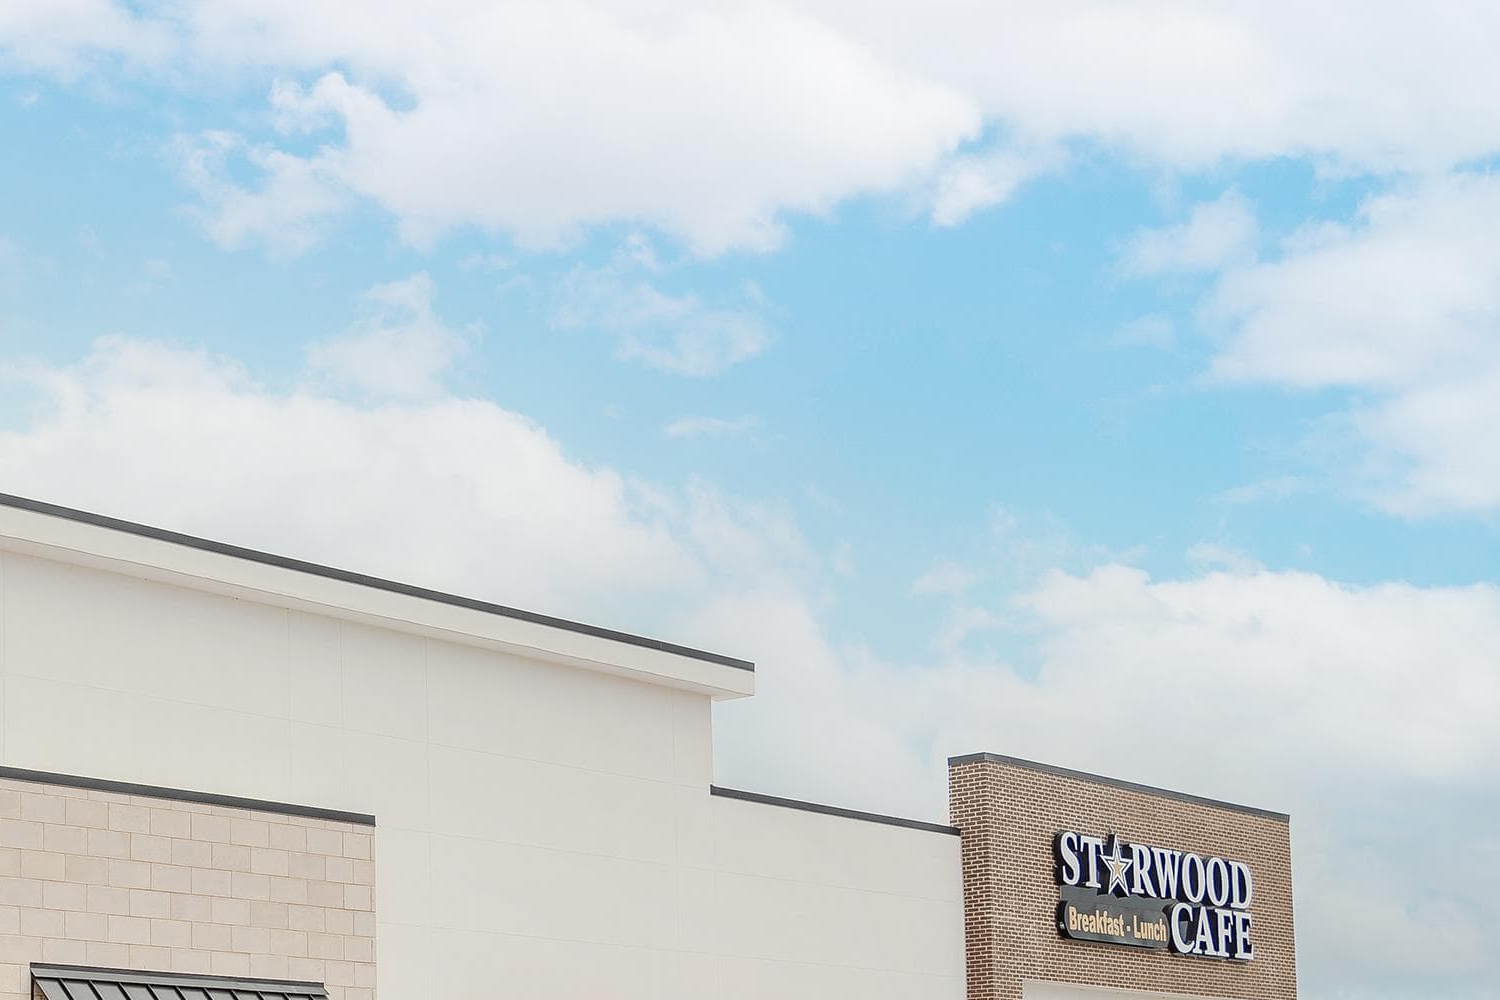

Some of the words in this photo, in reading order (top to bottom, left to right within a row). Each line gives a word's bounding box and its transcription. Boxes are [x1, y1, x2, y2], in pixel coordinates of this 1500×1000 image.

[1068, 906, 1125, 938] Breakfast
[1133, 915, 1167, 942] Lunch
[1171, 902, 1254, 960] CAFE
